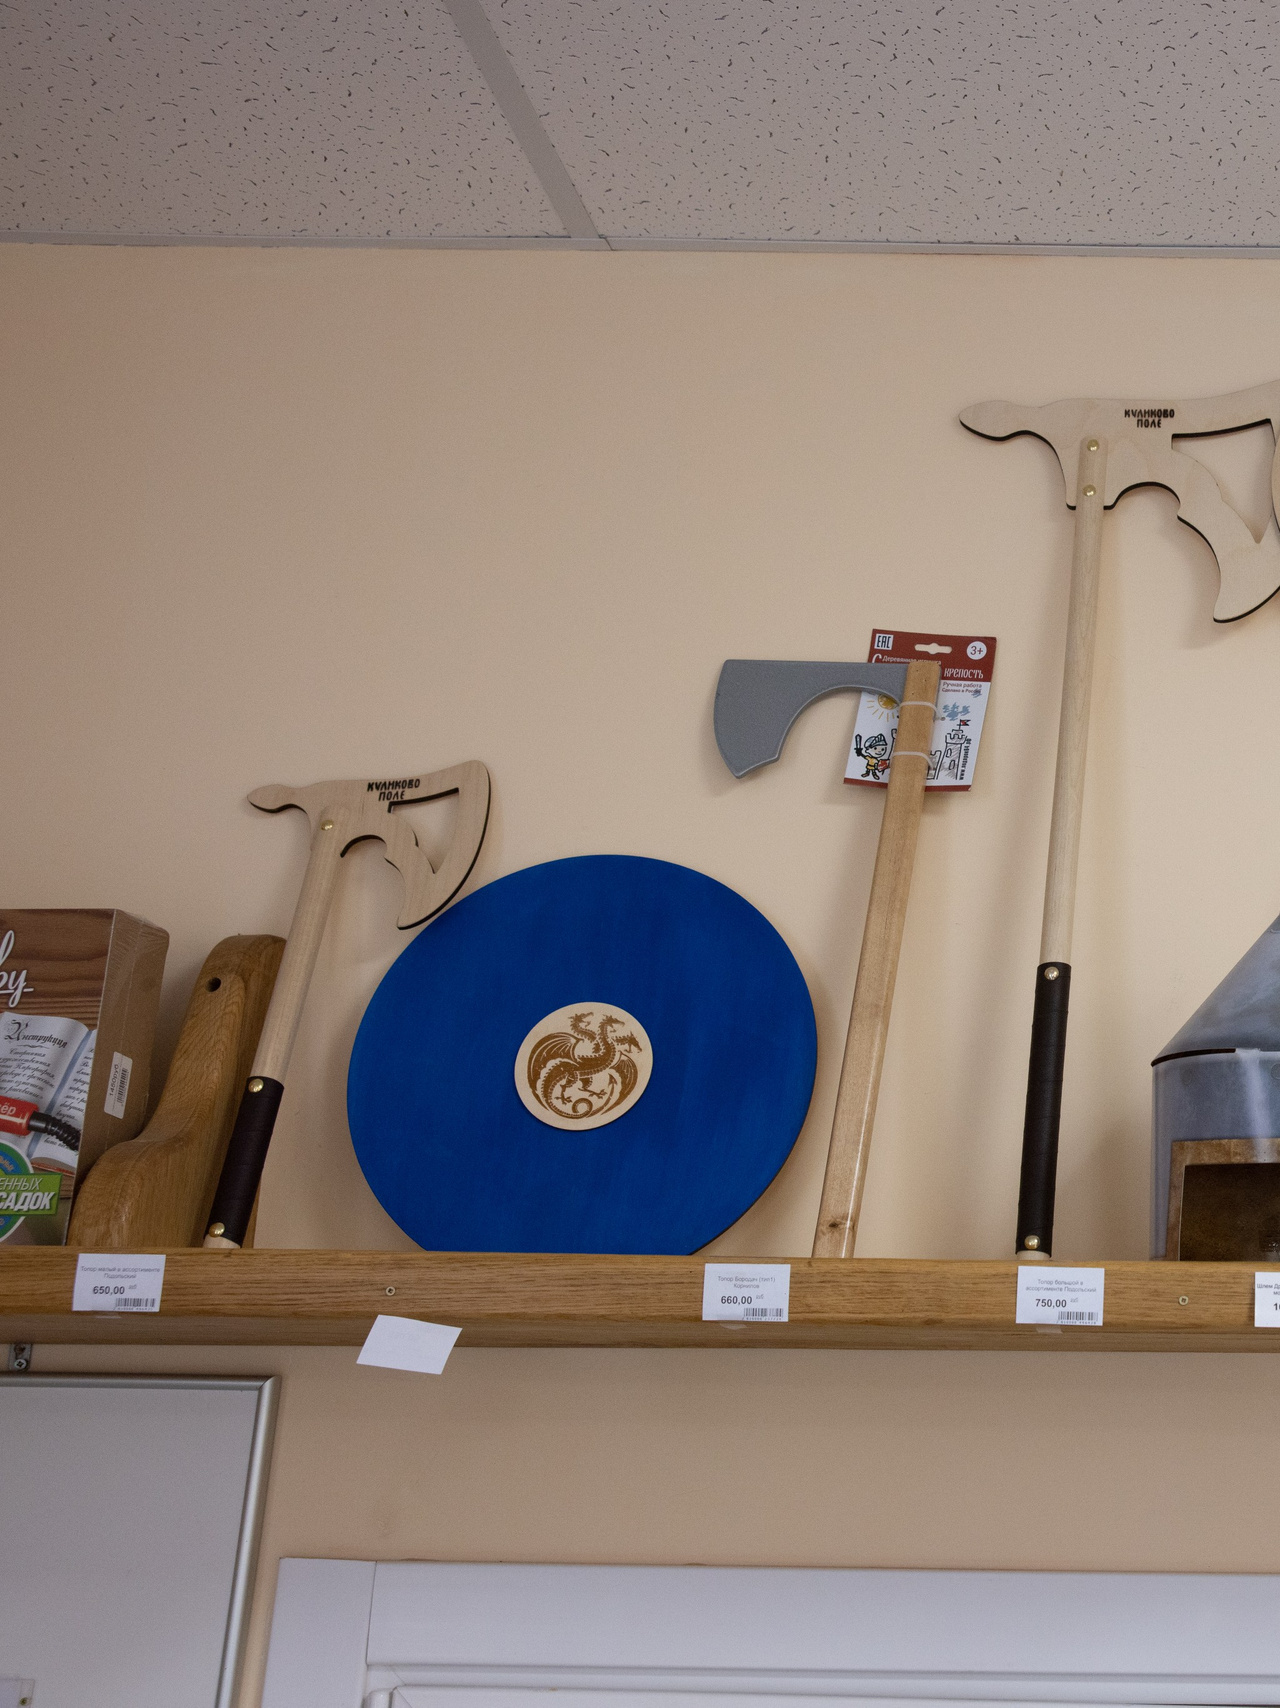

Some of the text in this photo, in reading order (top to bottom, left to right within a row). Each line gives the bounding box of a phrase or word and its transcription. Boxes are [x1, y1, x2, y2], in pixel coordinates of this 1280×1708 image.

[1124, 408, 1175, 418] КУЛИКОВО
[1136, 419, 1162, 428] ПОЛЕ
[970, 646, 984, 655] 3+
[367, 779, 420, 792] КУЛИКОВО
[378, 790, 405, 801] ПОЛЕ
[0, 1102, 16, 1115] ёр
[93, 1286, 125, 1295] 650,00
[721, 1296, 752, 1306] 660,00
[1036, 1299, 1067, 1309] 750,00
